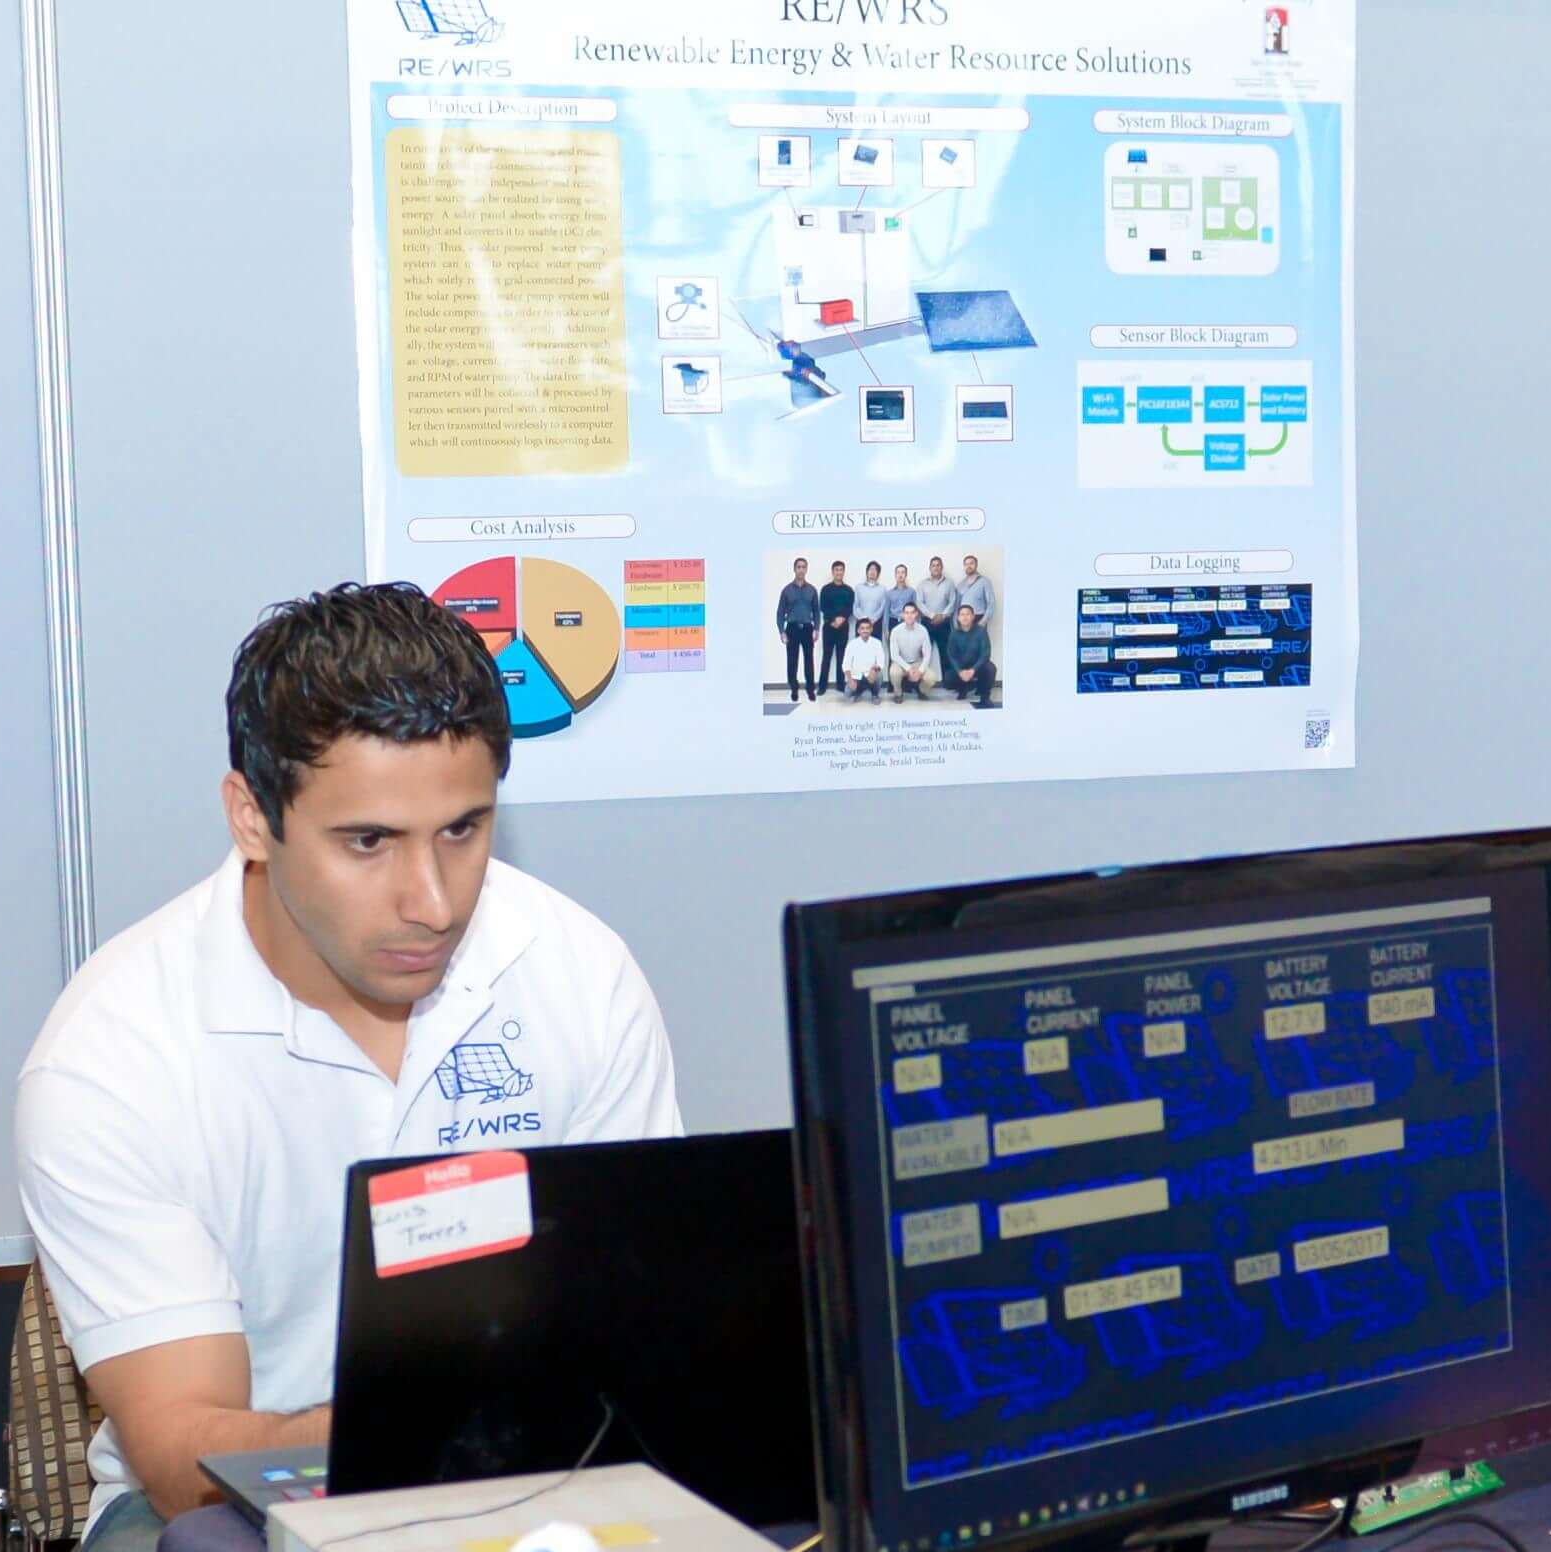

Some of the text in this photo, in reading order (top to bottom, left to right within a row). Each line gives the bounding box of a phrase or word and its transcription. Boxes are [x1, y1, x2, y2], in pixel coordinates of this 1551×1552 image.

[575, 36, 1191, 74] Renewable Energy & Water Resource Solutions
[399, 58, 512, 78] RE/WRS
[826, 108, 930, 127] System Layout
[1117, 114, 1270, 137] System Block Diagram
[1119, 327, 1269, 348] Sensor Block Diagram
[1088, 408, 1119, 416] Module
[470, 519, 575, 538] Cost Analysis
[790, 507, 969, 528] RE/WRS Team Members
[1150, 552, 1240, 573] Data Logging
[1370, 942, 1430, 966] BATTERY
[1266, 955, 1328, 979] BATTERY
[1370, 964, 1434, 988] CURRENT
[1144, 974, 1193, 993] PANEL
[1267, 977, 1331, 1000] VOLTAGE
[1025, 986, 1075, 1008] PANEL
[1146, 994, 1202, 1016] POWER
[892, 1003, 944, 1025] PANEL
[1026, 1007, 1100, 1034] CURRENT
[892, 1024, 969, 1051] VOLTAGE
[1292, 1084, 1371, 1112] FLOW RATE
[438, 1112, 542, 1147] RE/WRS
[900, 1125, 955, 1147] WATER
[900, 1146, 983, 1171] AVAILABLE
[424, 1163, 472, 1185] Hello
[908, 1213, 964, 1235] WATER
[909, 1234, 973, 1259] PUMPED
[1240, 1254, 1277, 1279] DATE
[1232, 1484, 1288, 1510] SAMSUNG
